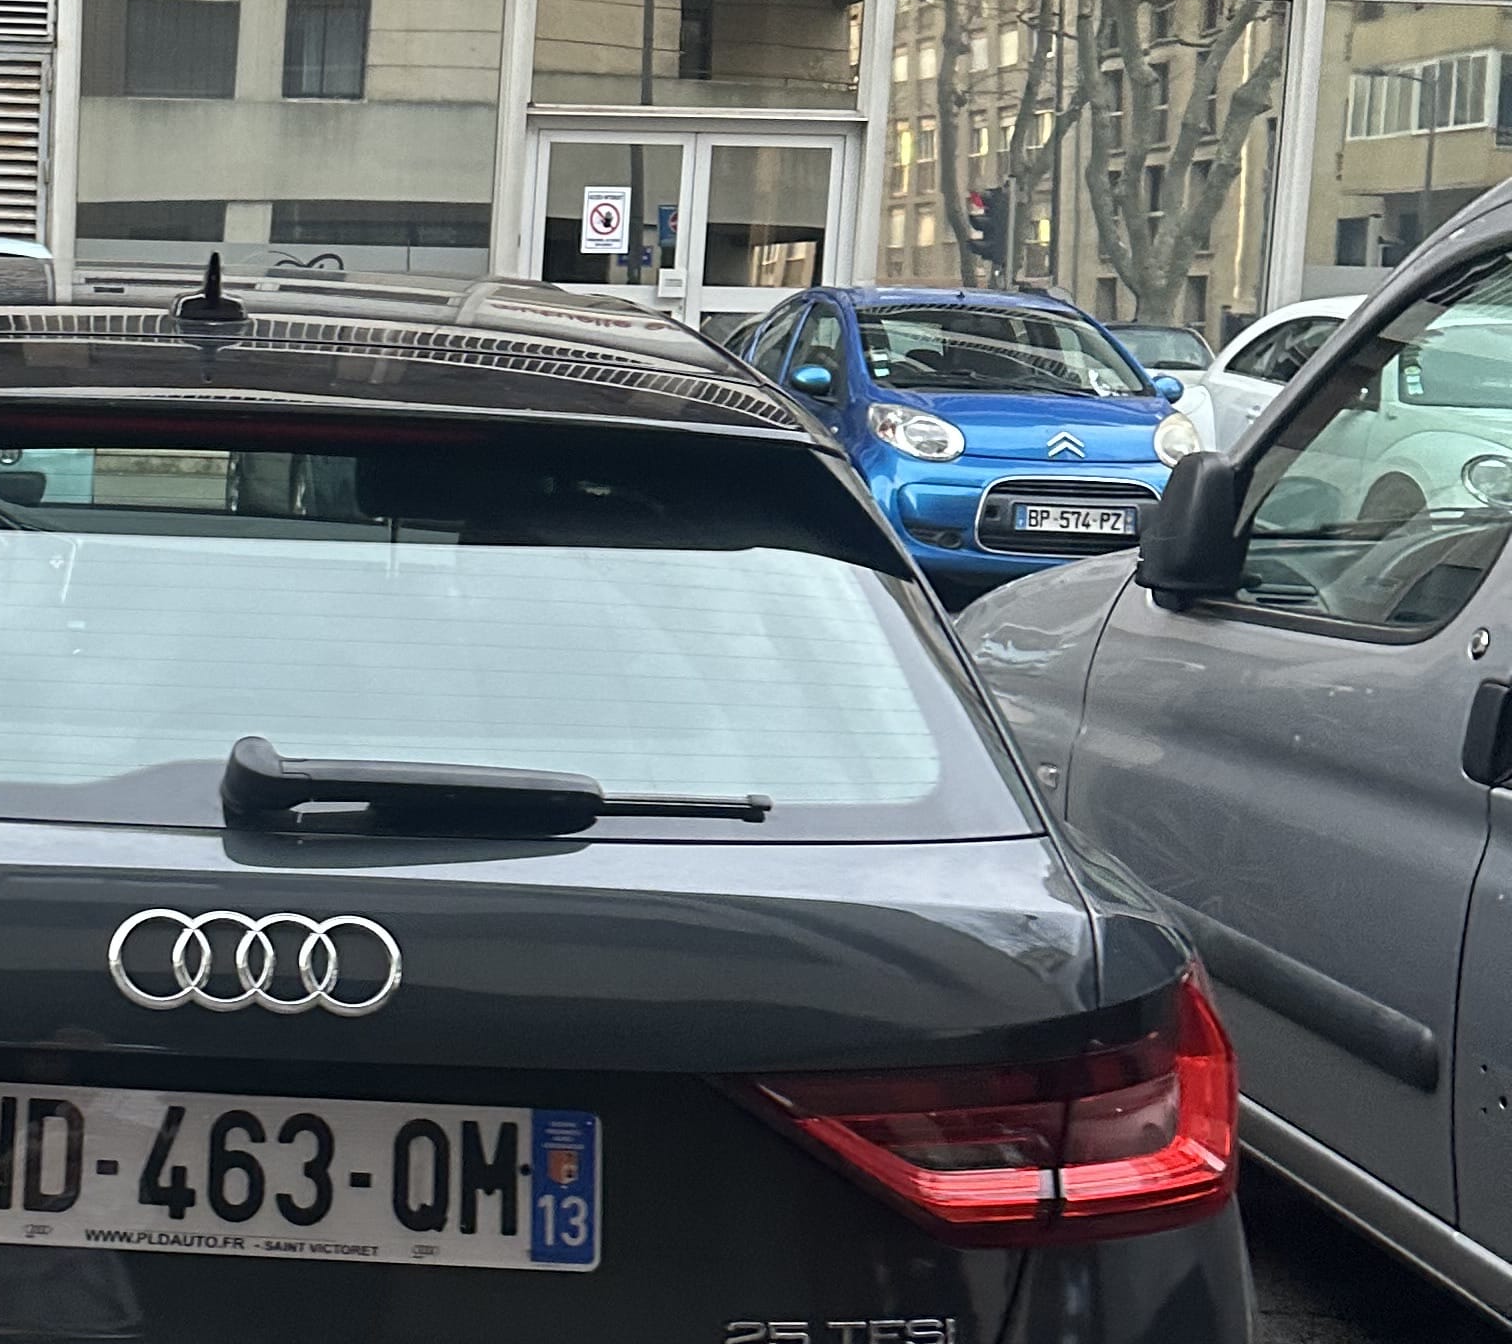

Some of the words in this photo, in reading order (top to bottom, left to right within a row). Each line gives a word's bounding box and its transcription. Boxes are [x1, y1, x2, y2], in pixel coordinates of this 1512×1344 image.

[1027, 509, 1123, 531] BP-574-PZ
[537, 1193, 588, 1247] 13
[84, 1228, 245, 1251] WWW.PLDAUTO.FR
[264, 1240, 305, 1253] SAINT
[310, 1243, 379, 1257] VICTORET
